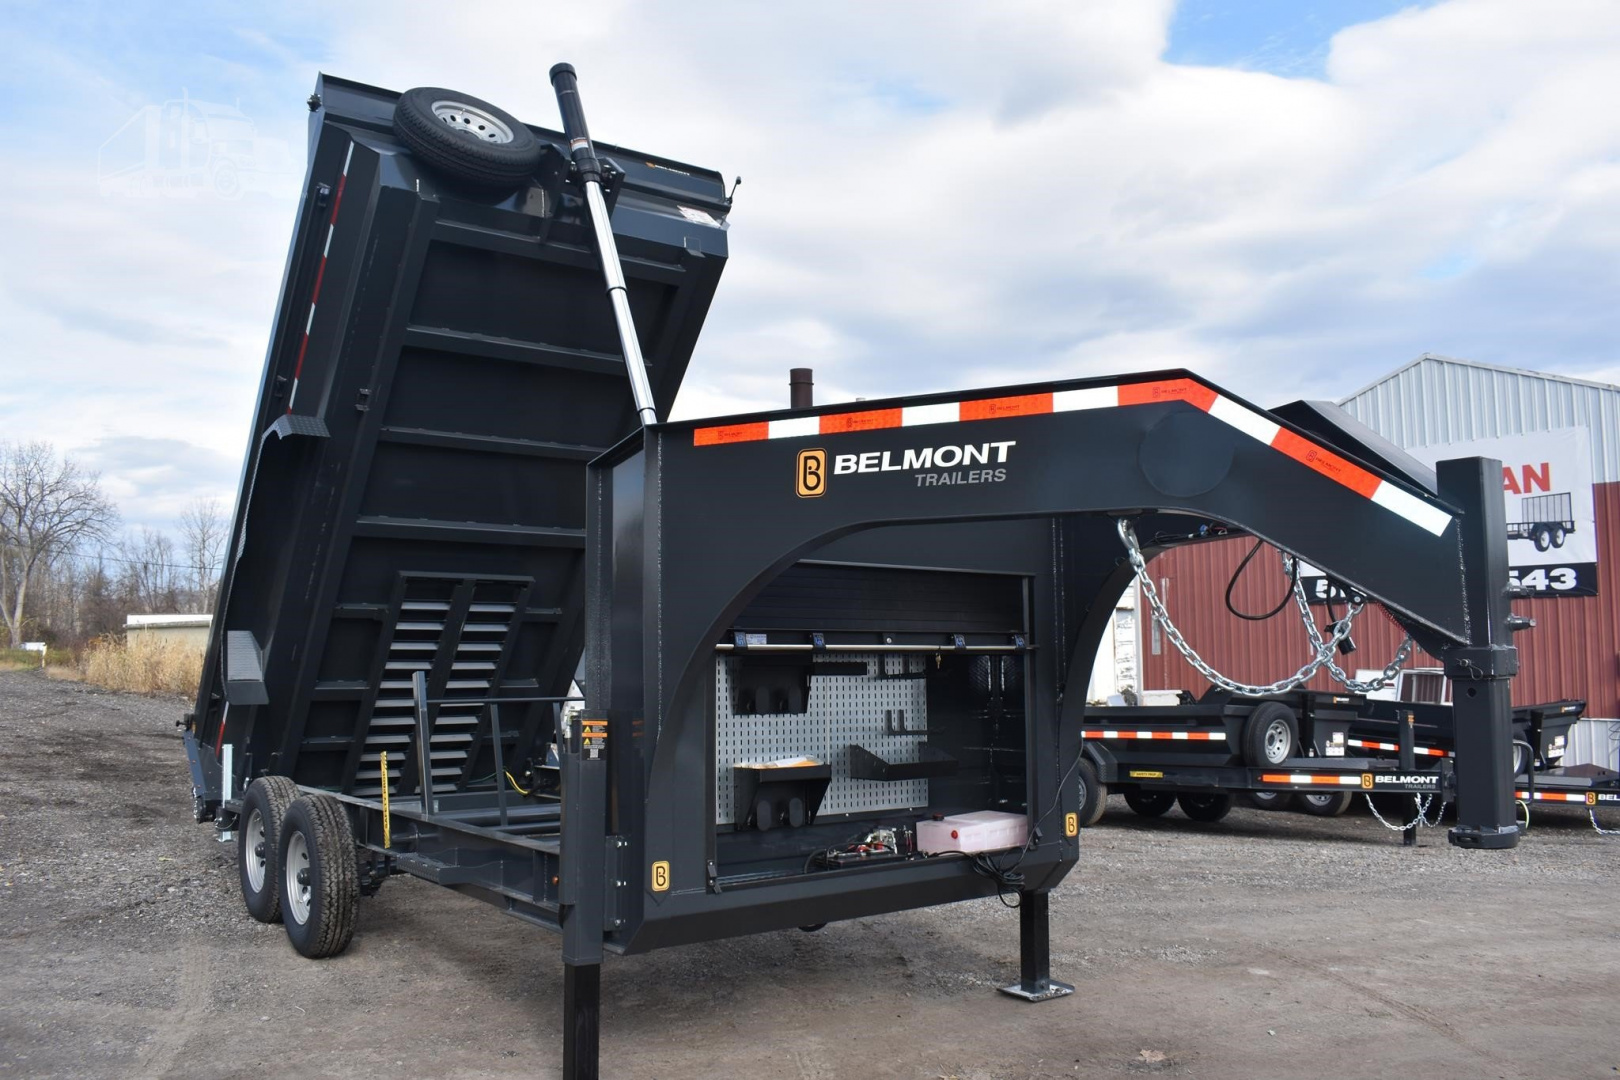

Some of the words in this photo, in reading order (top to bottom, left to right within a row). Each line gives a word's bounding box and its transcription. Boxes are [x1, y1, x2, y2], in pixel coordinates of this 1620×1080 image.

[833, 441, 1017, 475] BELMONT
[914, 468, 1007, 487] TRAILERS
[1375, 775, 1439, 784] BELMONT
